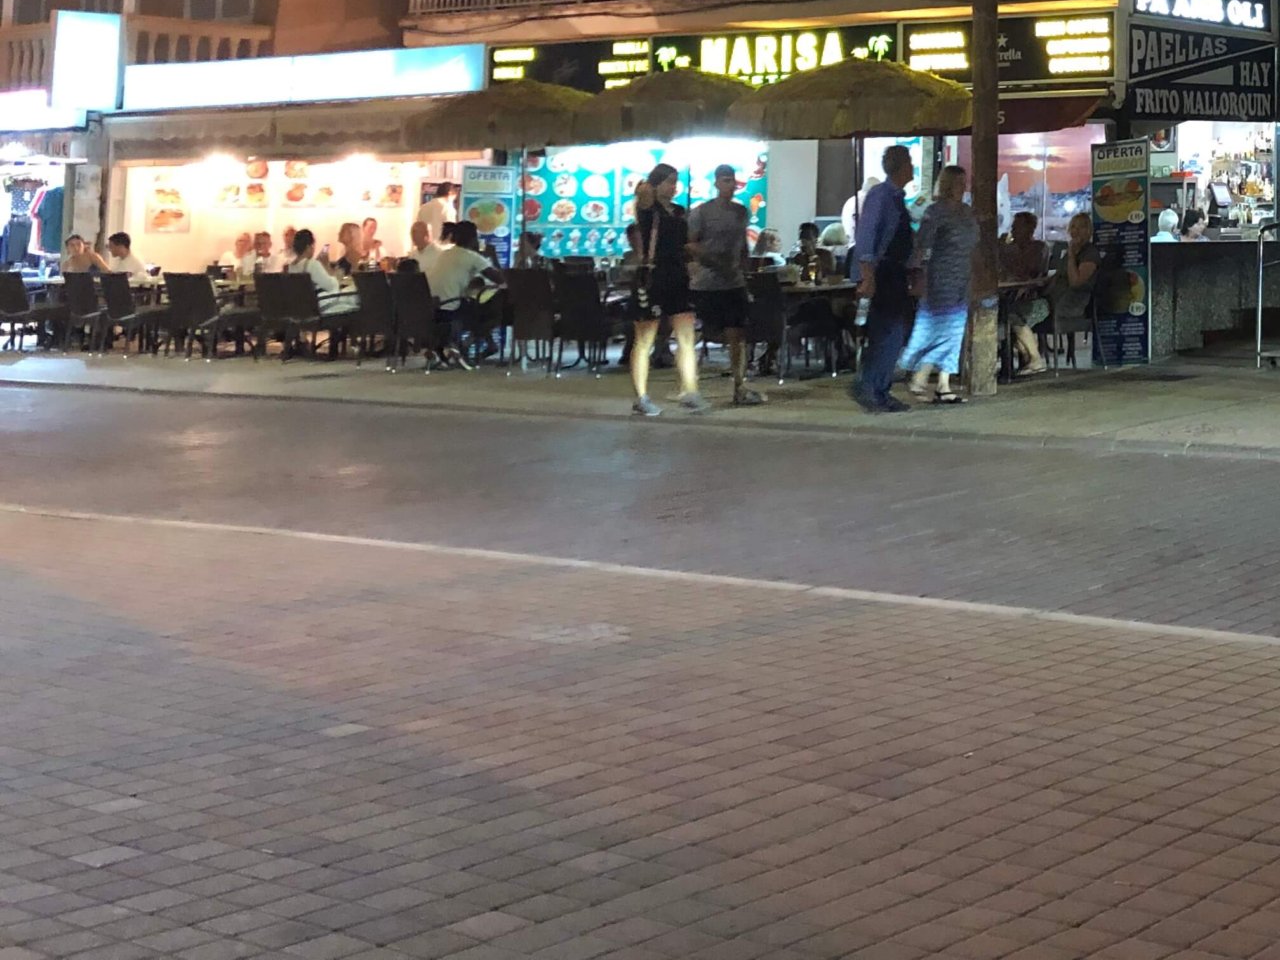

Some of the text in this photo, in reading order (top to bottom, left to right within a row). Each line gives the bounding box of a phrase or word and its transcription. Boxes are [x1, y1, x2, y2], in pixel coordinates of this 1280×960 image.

[1227, 0, 1265, 28] OLI
[701, 31, 843, 75] MARISA
[1131, 29, 1228, 74] PAELLAS
[1239, 61, 1271, 87] HAY
[1135, 88, 1271, 120] FRITO MALLORQUIN
[1097, 146, 1143, 159] OFERTA
[468, 171, 510, 182] OFERTA
